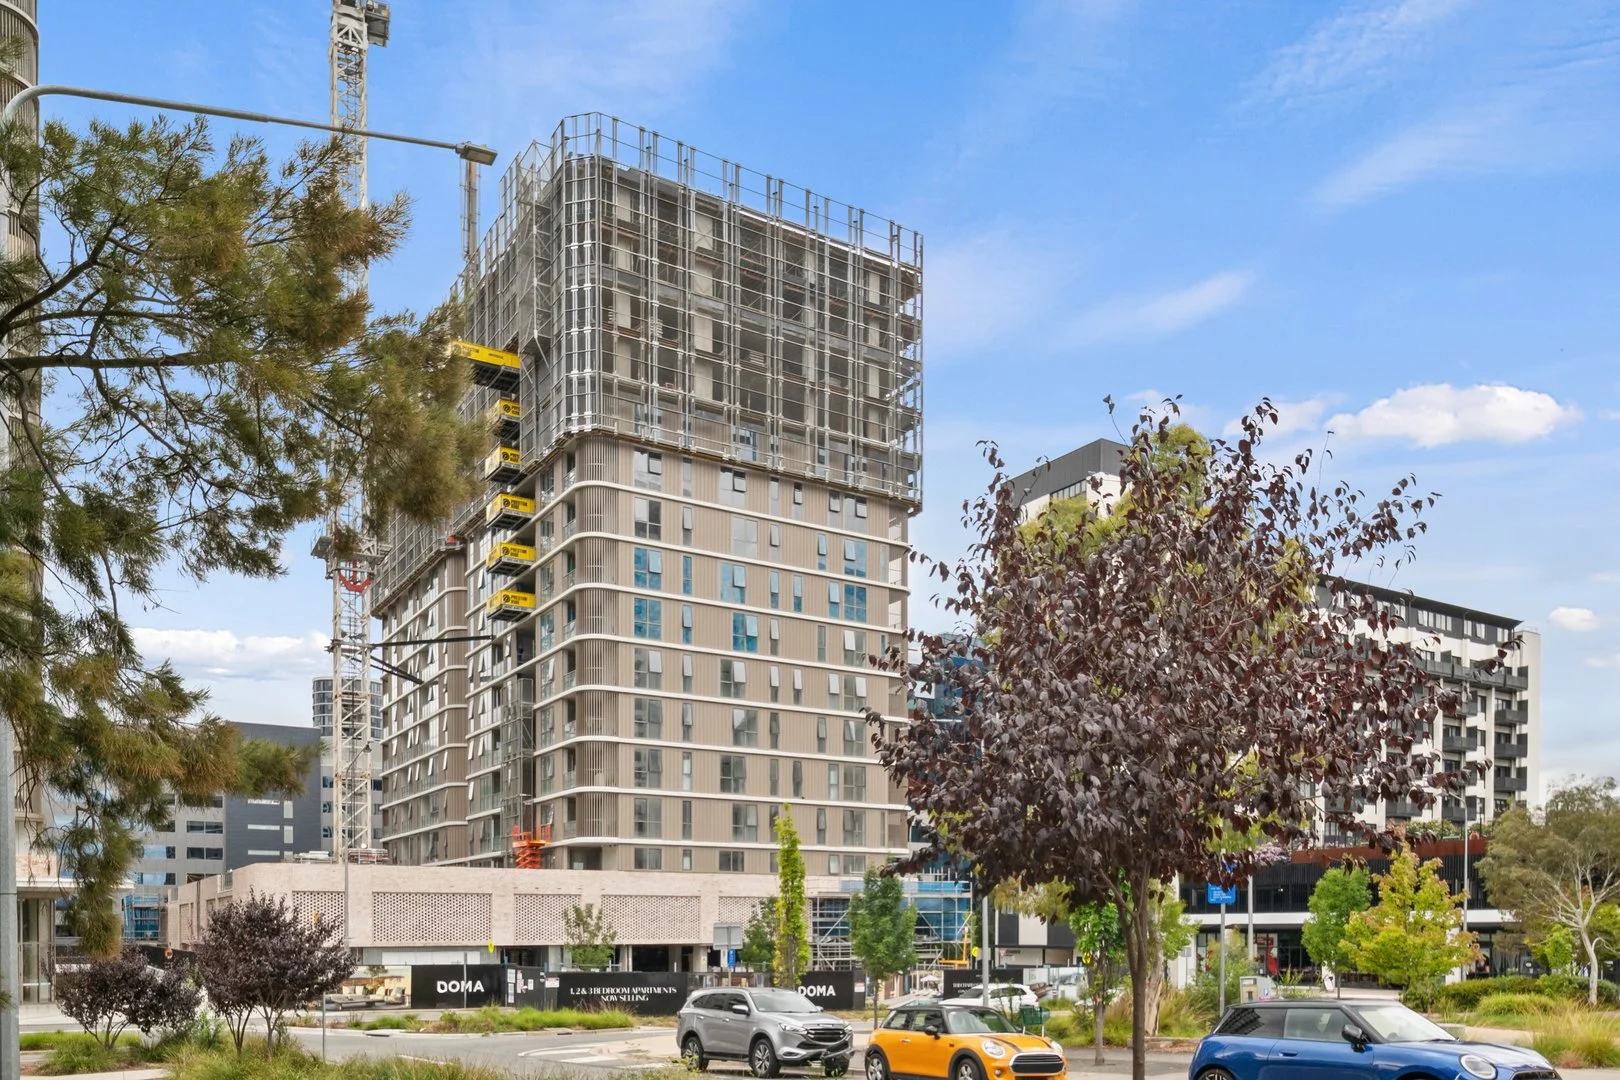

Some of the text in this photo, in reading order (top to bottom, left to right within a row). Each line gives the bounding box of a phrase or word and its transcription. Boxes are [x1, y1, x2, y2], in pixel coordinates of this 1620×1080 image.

[436, 980, 485, 994] DOMA
[593, 987, 631, 995] BEDROOM
[797, 985, 836, 997] DOMA
[619, 994, 649, 1002] SELLING
